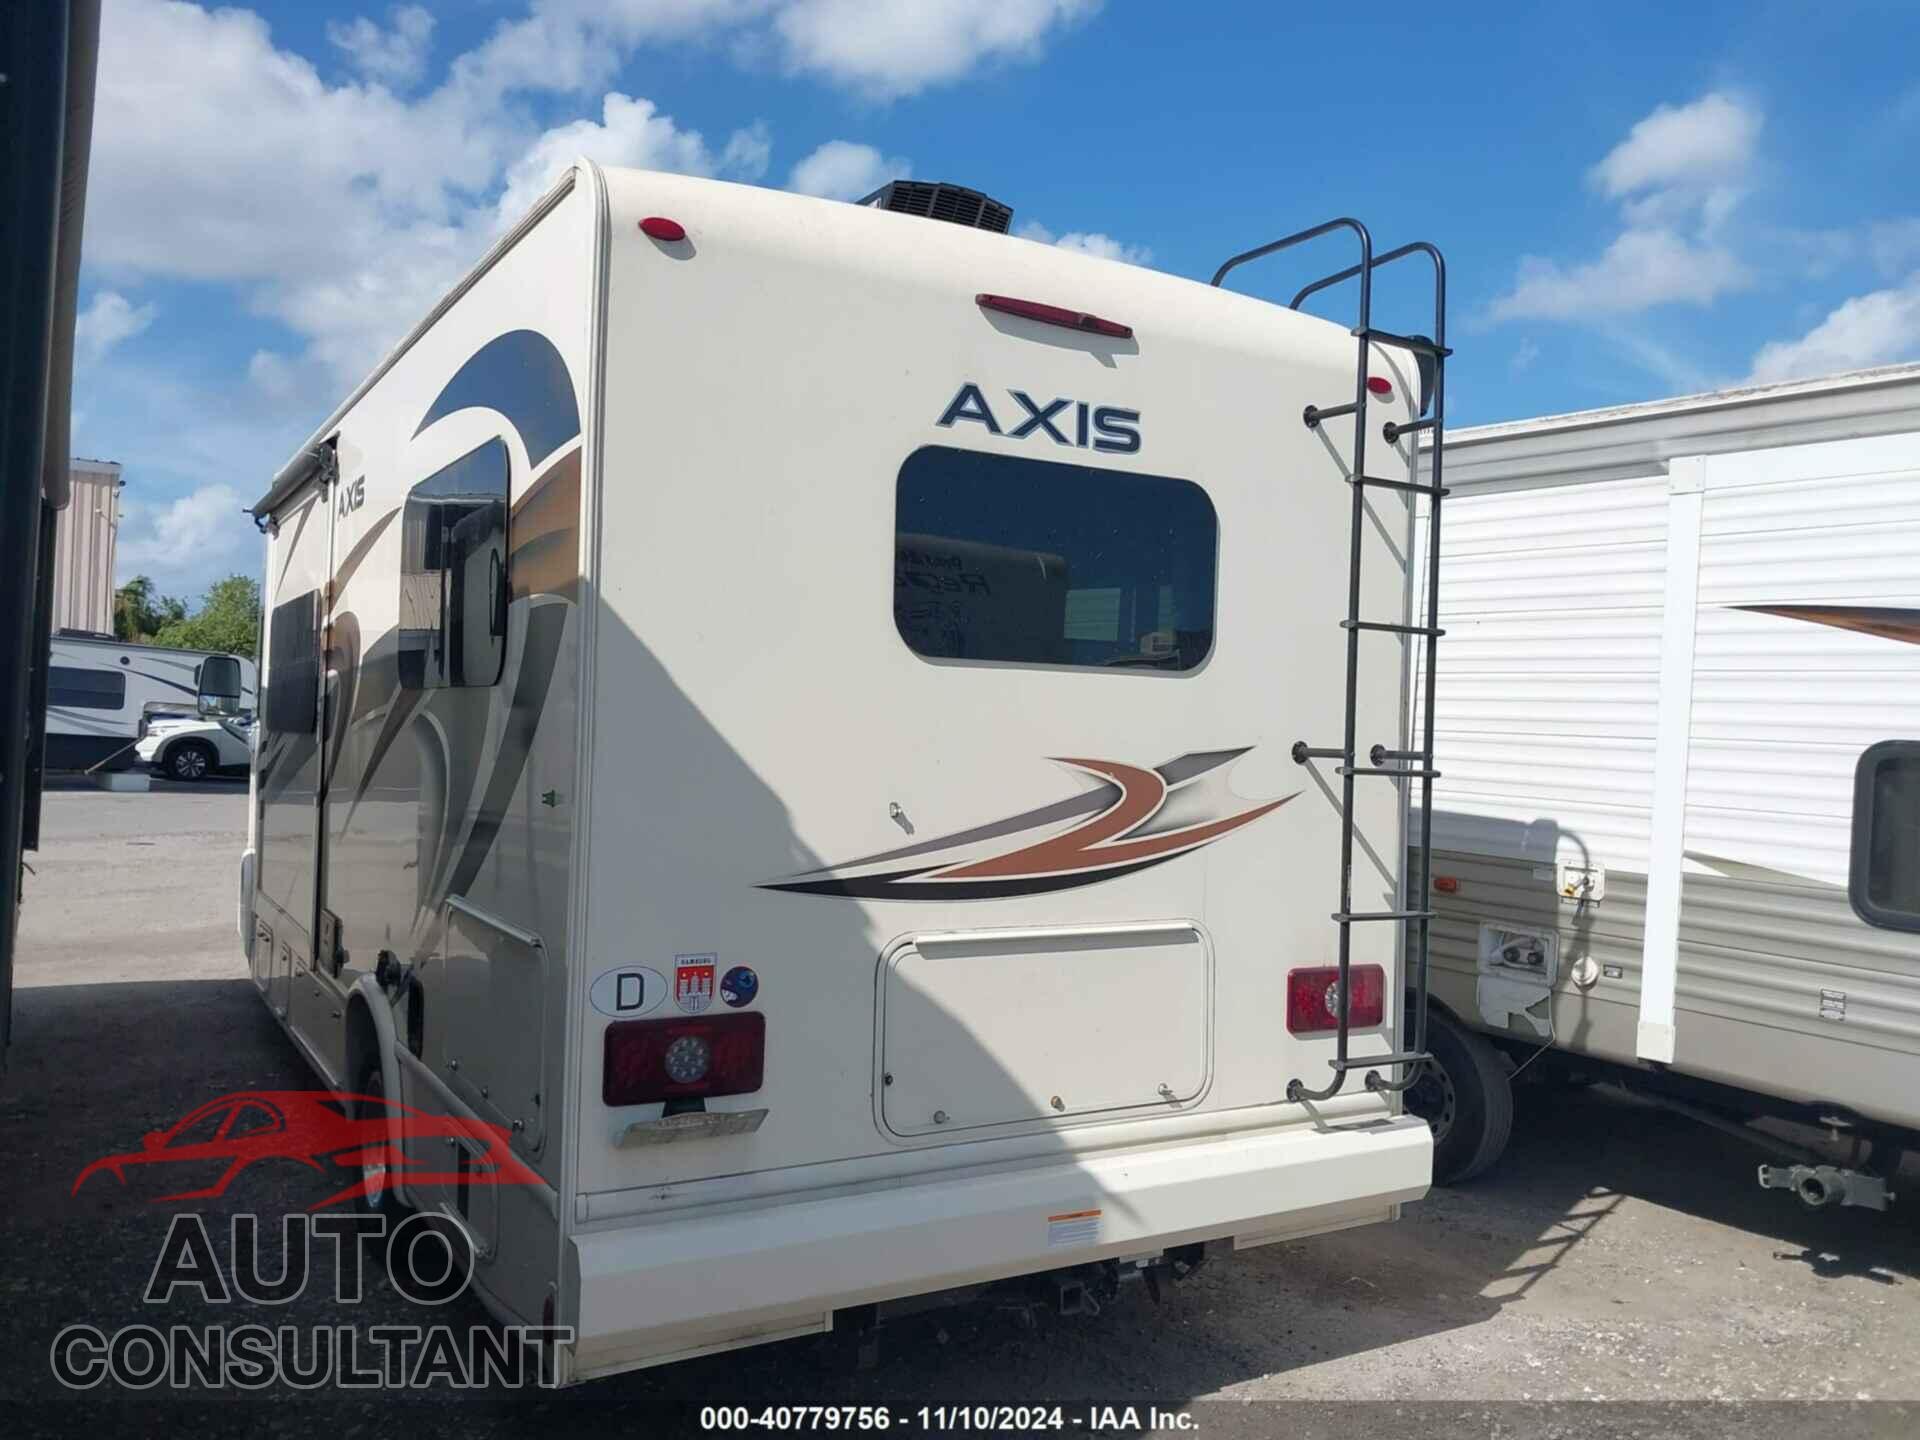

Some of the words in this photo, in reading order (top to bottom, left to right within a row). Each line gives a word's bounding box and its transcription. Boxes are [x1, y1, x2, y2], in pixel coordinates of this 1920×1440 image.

[937, 382, 1141, 455] AXIS
[338, 475, 365, 521] AXIS
[616, 973, 645, 1011] D
